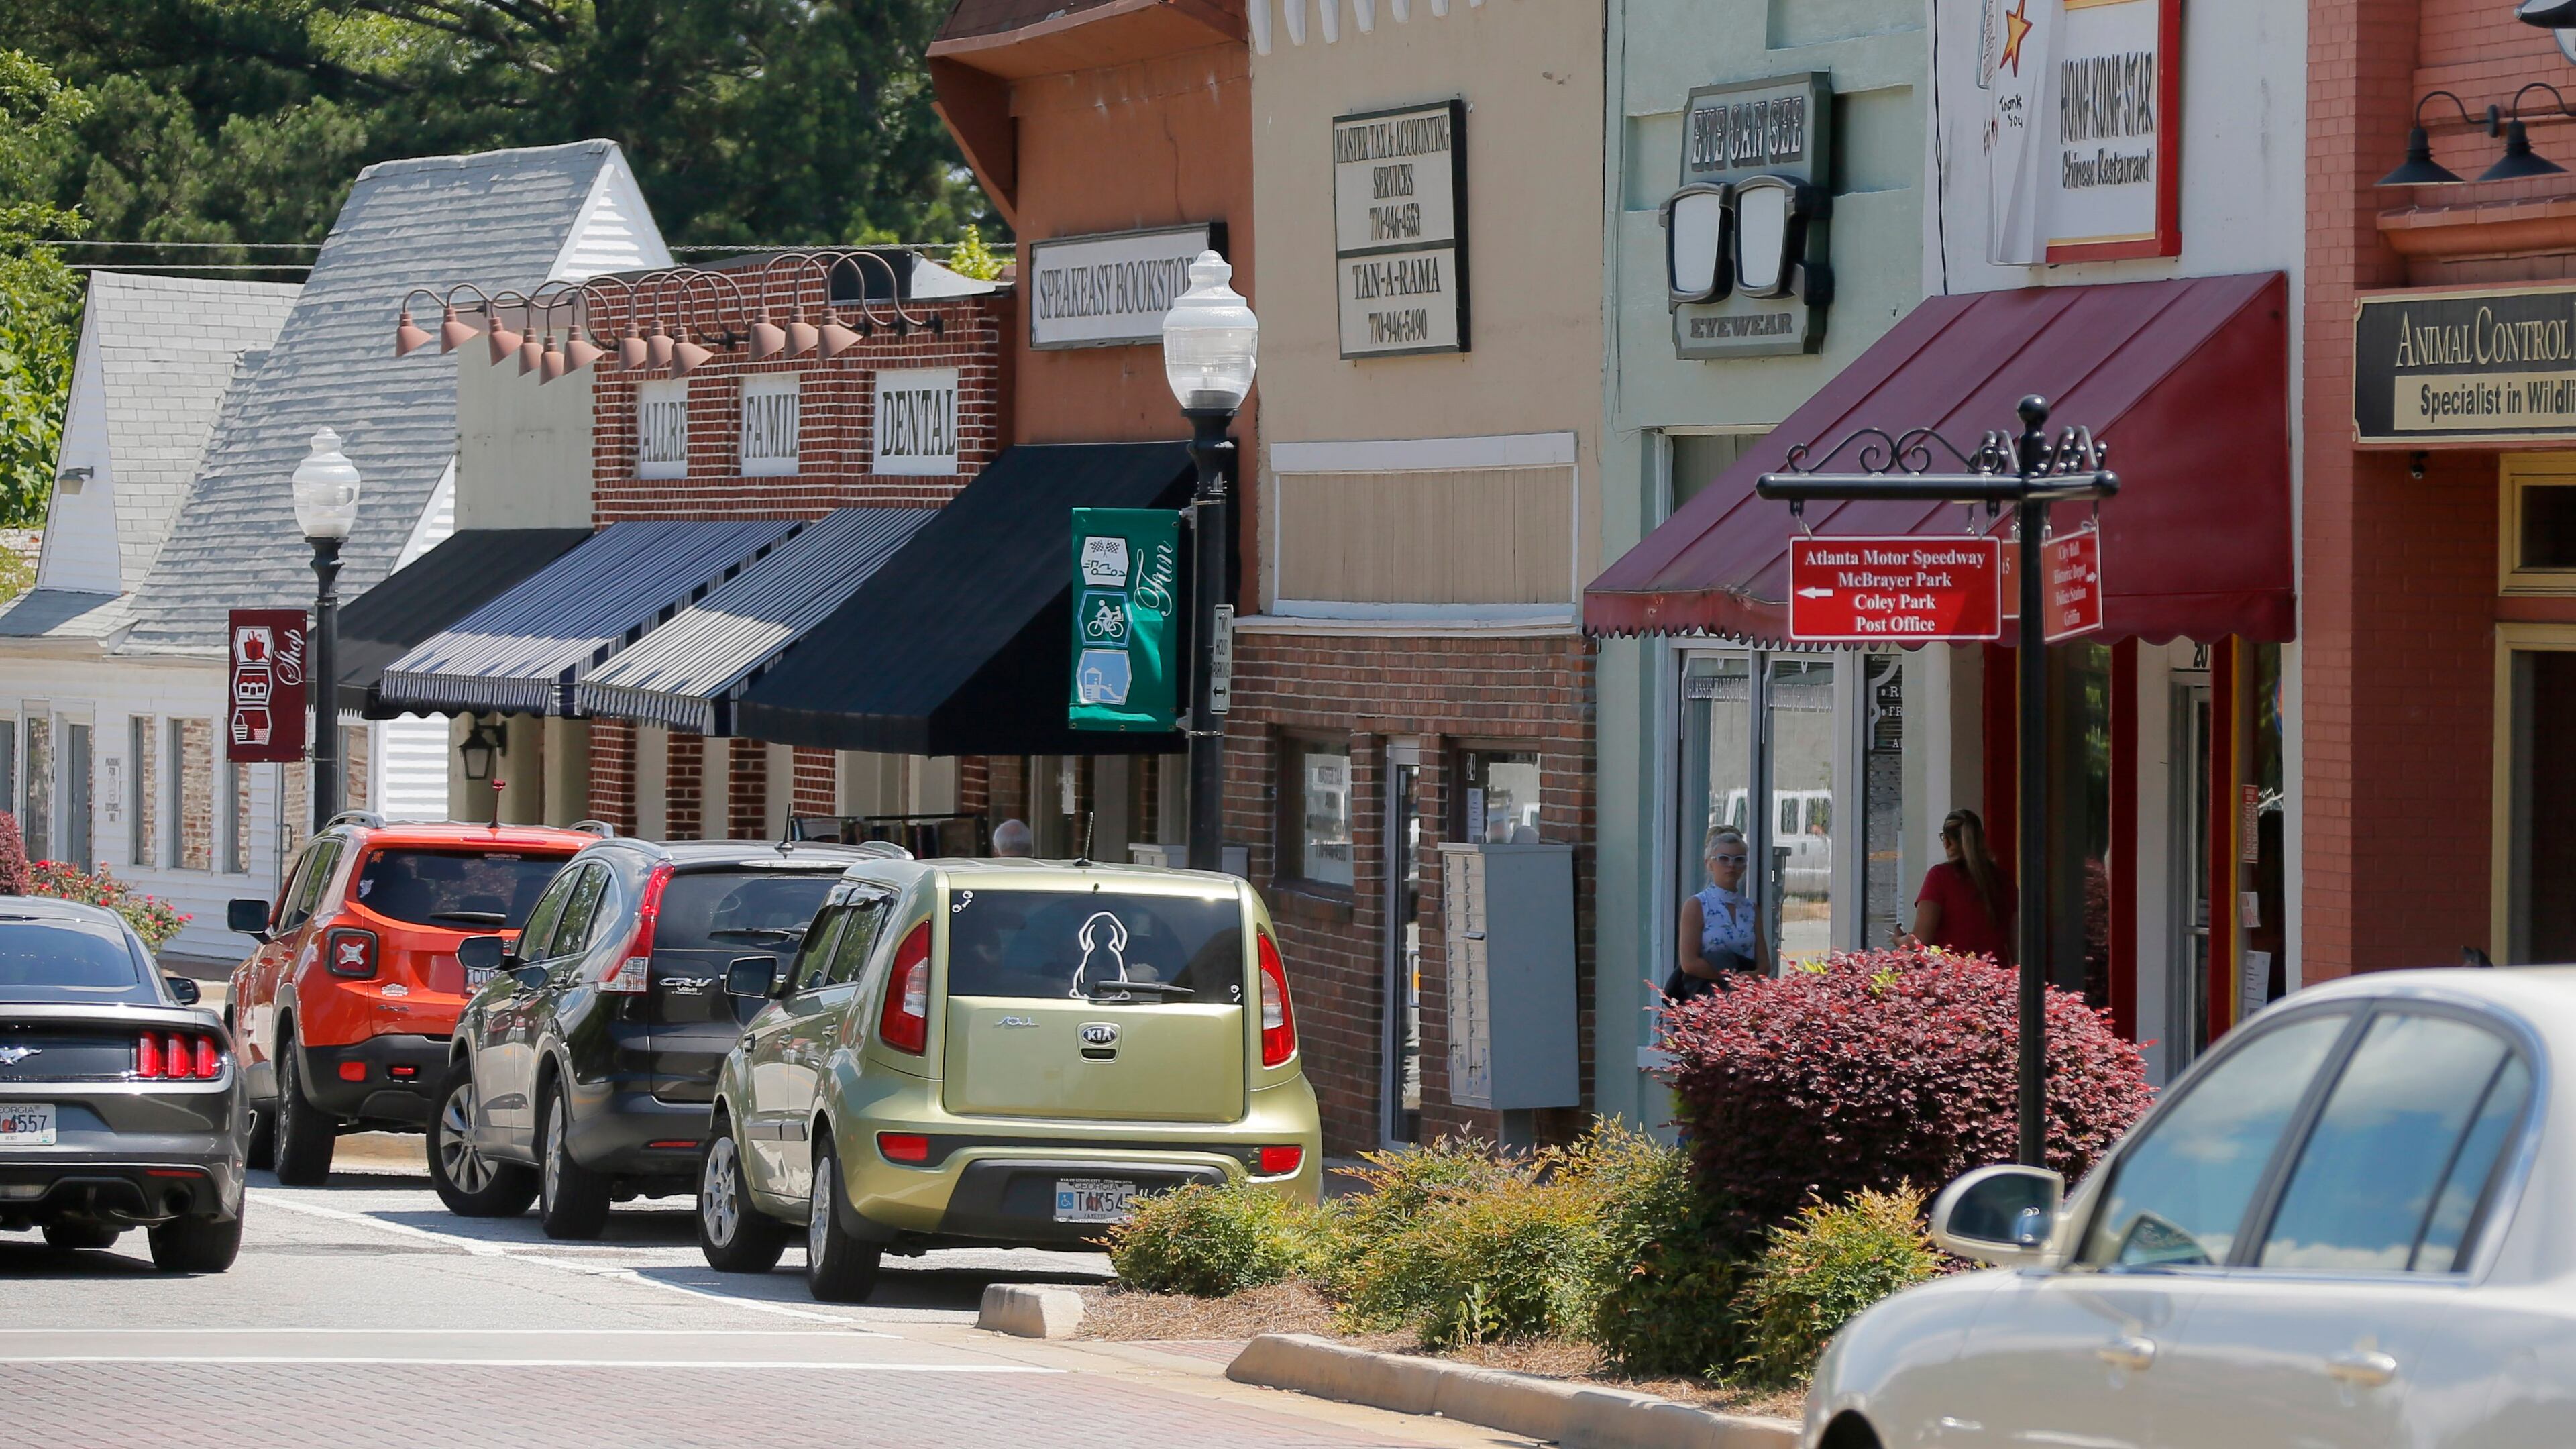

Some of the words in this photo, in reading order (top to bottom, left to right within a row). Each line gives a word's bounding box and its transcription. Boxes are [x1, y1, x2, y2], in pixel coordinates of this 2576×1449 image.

[2061, 59, 2089, 145] HONG
[2092, 54, 2122, 138] KONG
[2124, 51, 2154, 136] STAR
[1336, 126, 1369, 163] MASTER
[1370, 123, 1387, 160] TAX
[1388, 122, 1395, 158] &
[1396, 114, 1449, 157] ACCOUNTING
[1691, 106, 1727, 168] EYE
[1729, 102, 1768, 166] CAN
[1769, 96, 1804, 162] SEE
[1373, 164, 1413, 199] SERVICES
[2062, 150, 2095, 189] Chinese
[2098, 147, 2151, 186] Restaurant
[1369, 203, 1421, 241] 770-946-4553
[1039, 264, 1113, 320] SPEAKEASY
[1352, 257, 1442, 299] TAN-A-RAMA
[1368, 308, 1428, 344] 770-946-5490
[1690, 313, 1793, 338] EYEWEAR
[2395, 311, 2473, 367] ANIMAL
[2475, 305, 2572, 365] CONTROL
[2421, 382, 2501, 423] Specialist
[2507, 382, 2522, 414] in
[881, 389, 957, 456] DENTAL
[1805, 549, 1859, 566] Atlanta
[1863, 549, 1909, 566] Motor
[1913, 549, 1986, 569] Speedway
[1134, 540, 1173, 617] Fun
[1838, 572, 1913, 591] McBrayer
[1916, 572, 1953, 588] Park
[1854, 594, 1896, 614] Coley
[1899, 594, 1937, 610] Park
[1856, 616, 1887, 633] Post
[1890, 615, 1936, 632] Office
[274, 629, 305, 686] Shop
[1890, 686, 1902, 697] R
[659, 977, 713, 987] CR-V
[1087, 1030, 1111, 1041] KIA
[1073, 1183, 1118, 1191] GEORGIA
